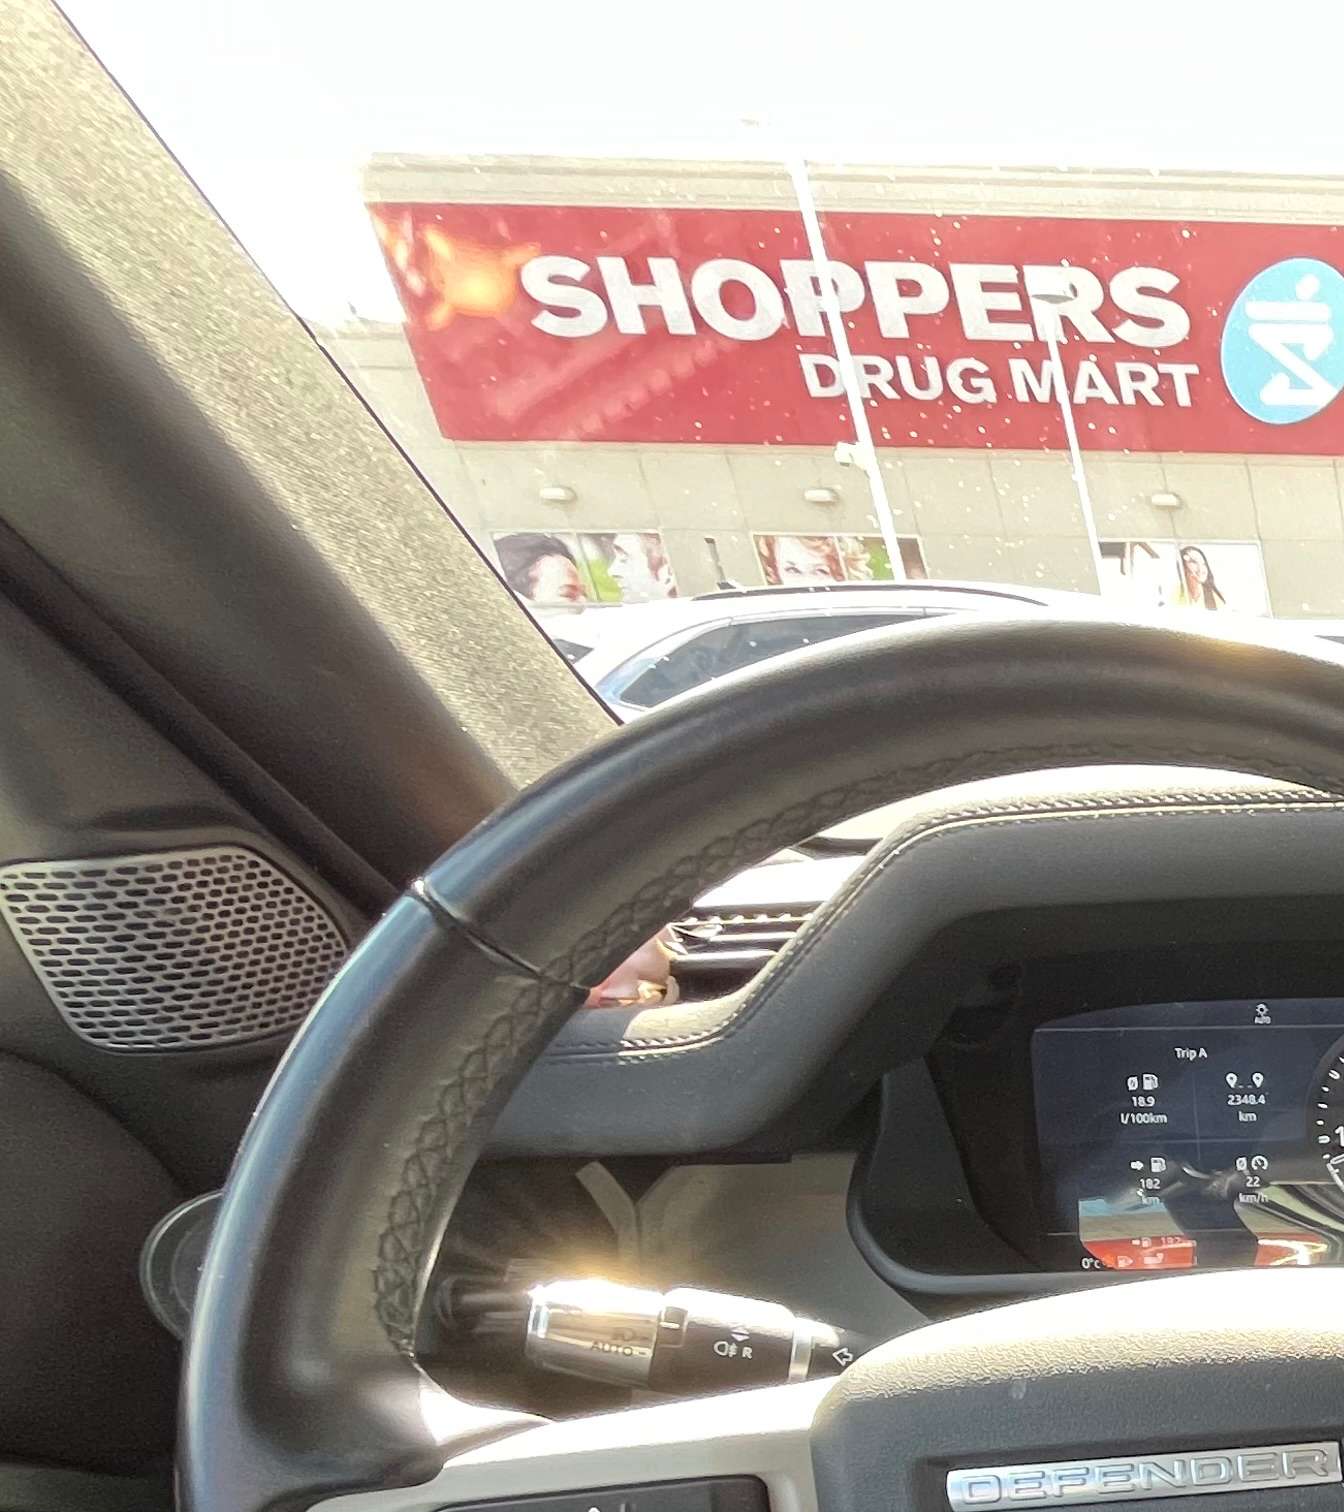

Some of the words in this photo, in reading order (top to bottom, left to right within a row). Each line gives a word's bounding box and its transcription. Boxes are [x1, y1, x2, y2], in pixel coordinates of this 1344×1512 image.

[519, 254, 1192, 348] SHOPPERS
[799, 353, 998, 404] DRUG
[1009, 359, 1200, 407] MART
[1174, 1048, 1197, 1060] Trip
[1199, 1048, 1208, 1059] A
[1131, 1095, 1155, 1107] 18.9
[1227, 1094, 1266, 1105] 2348.4
[1238, 1111, 1257, 1122] km
[1246, 1176, 1261, 1187] 22
[1238, 1191, 1268, 1203] km/h
[959, 1447, 1331, 1506] DEFENDER
